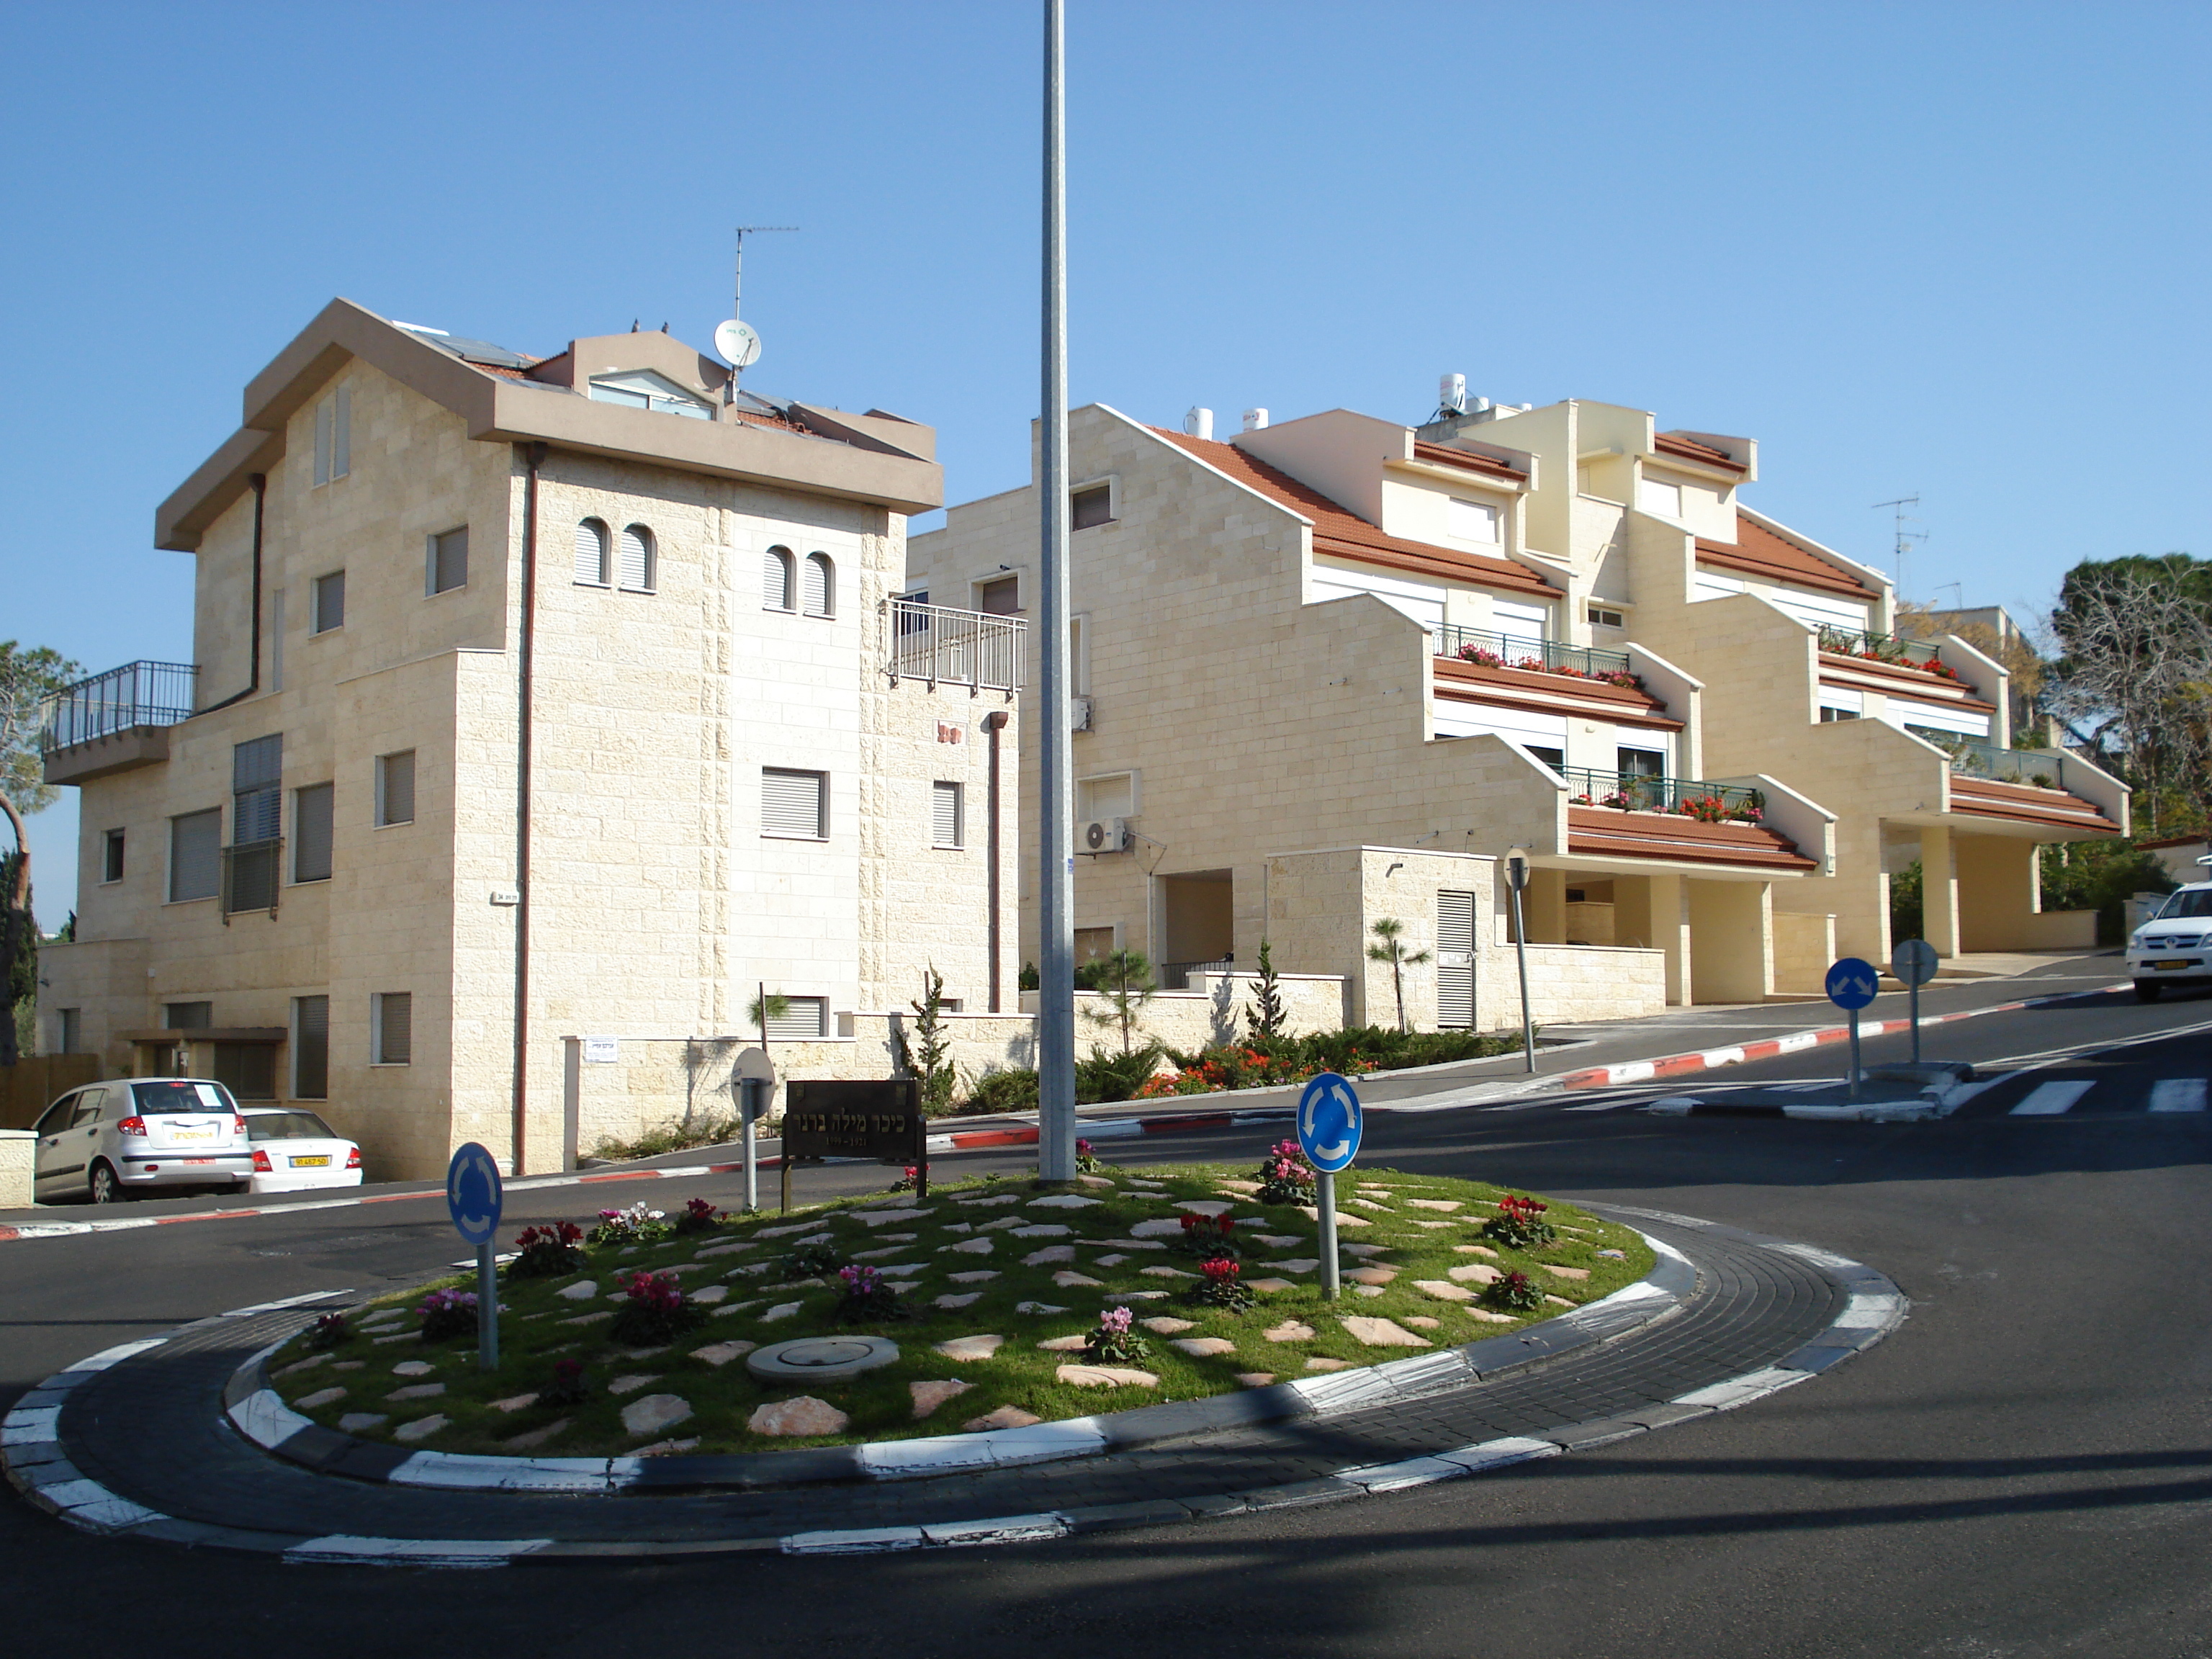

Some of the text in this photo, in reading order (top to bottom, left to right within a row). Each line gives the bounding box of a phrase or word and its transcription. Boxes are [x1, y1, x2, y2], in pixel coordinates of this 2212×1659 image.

[793, 1107, 906, 1133] כיכר מילה ברנר
[826, 1136, 842, 1146] 1999
[850, 1137, 867, 1146] 1921
